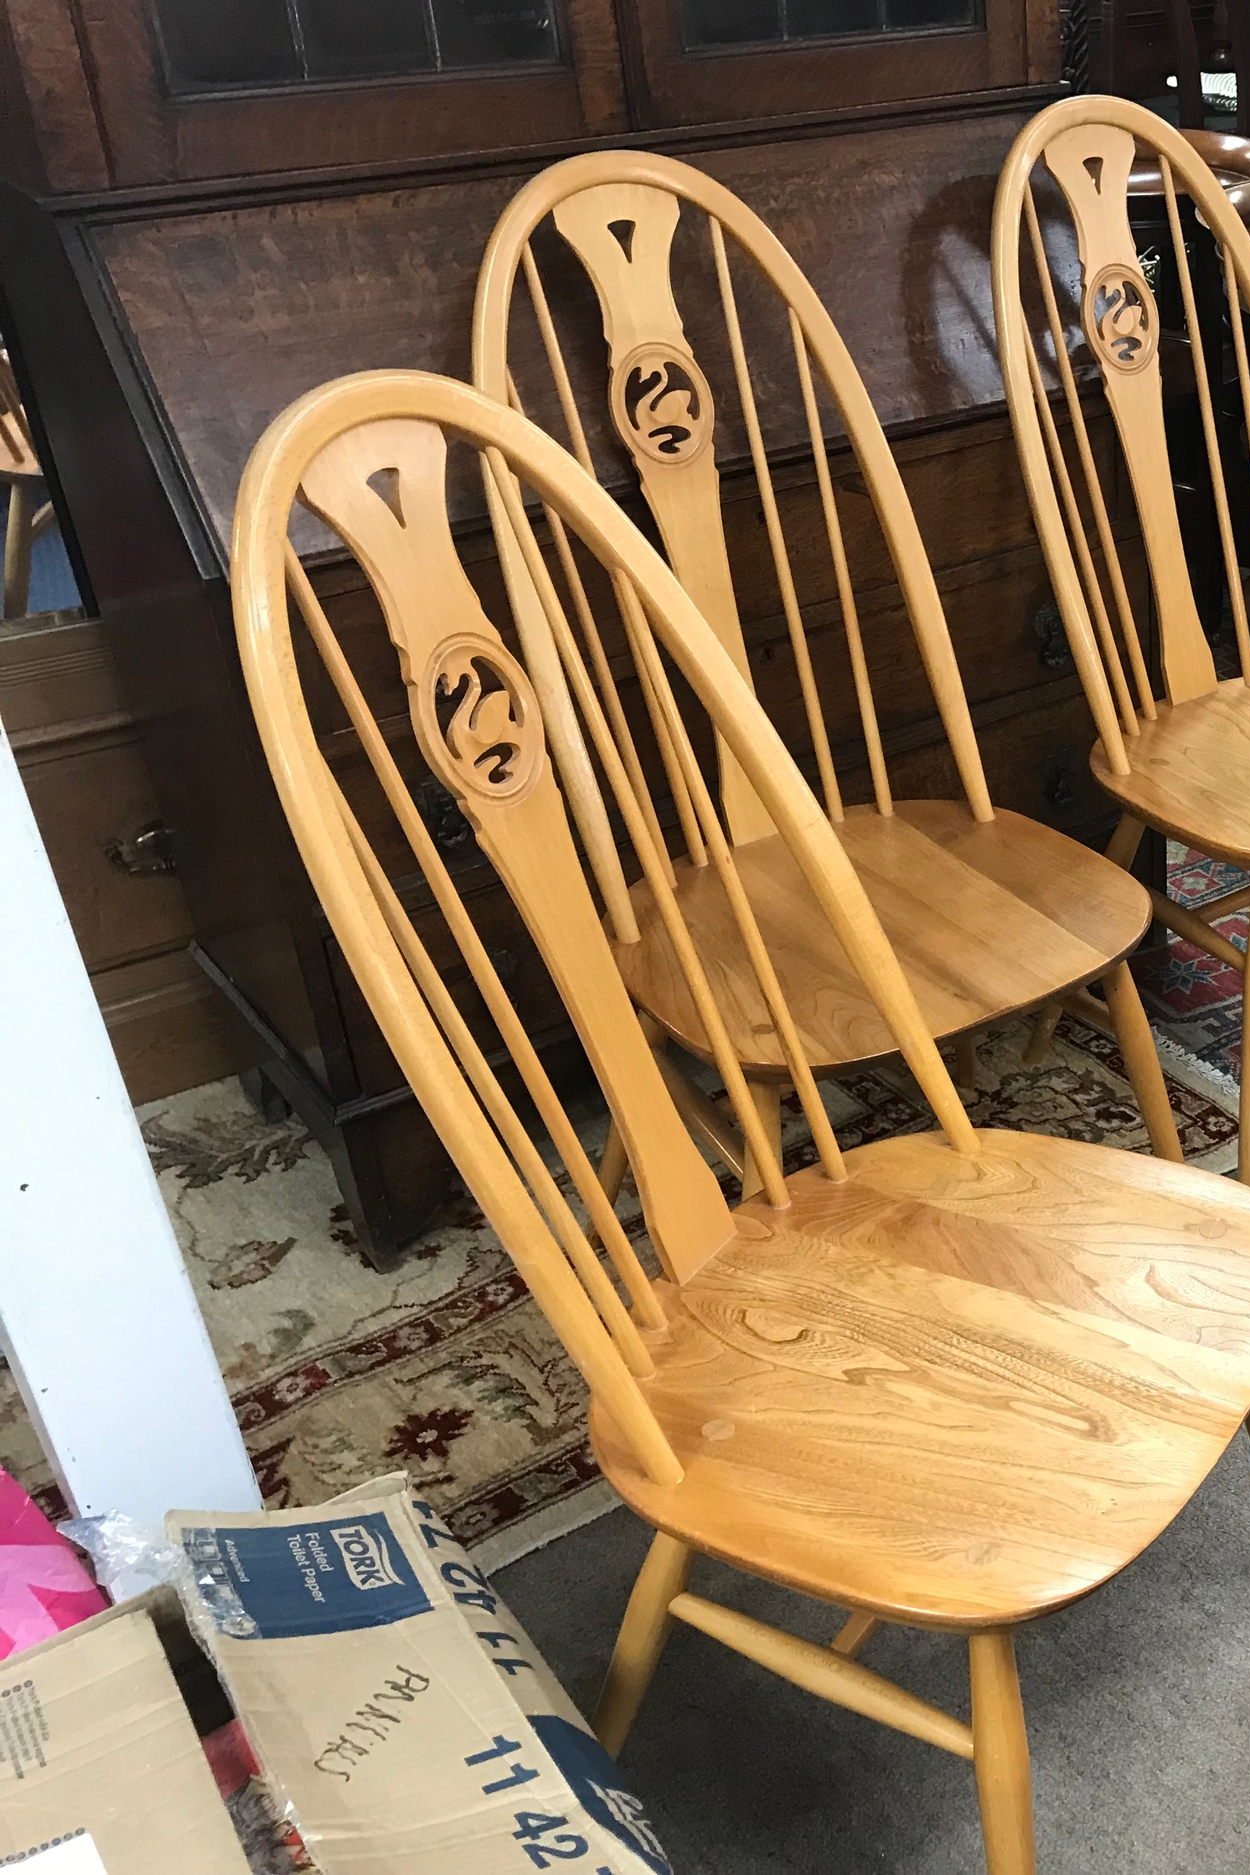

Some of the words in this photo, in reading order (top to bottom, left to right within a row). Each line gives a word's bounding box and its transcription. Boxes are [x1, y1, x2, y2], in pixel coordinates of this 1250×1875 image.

[224, 1539, 251, 1583] Advanced
[287, 1534, 310, 1566] Toilet
[301, 1568, 326, 1603] Paper
[305, 1532, 334, 1572] Folded
[338, 1529, 385, 1586] TORK
[464, 1735, 540, 1795] 11
[512, 1811, 589, 1869] 42
